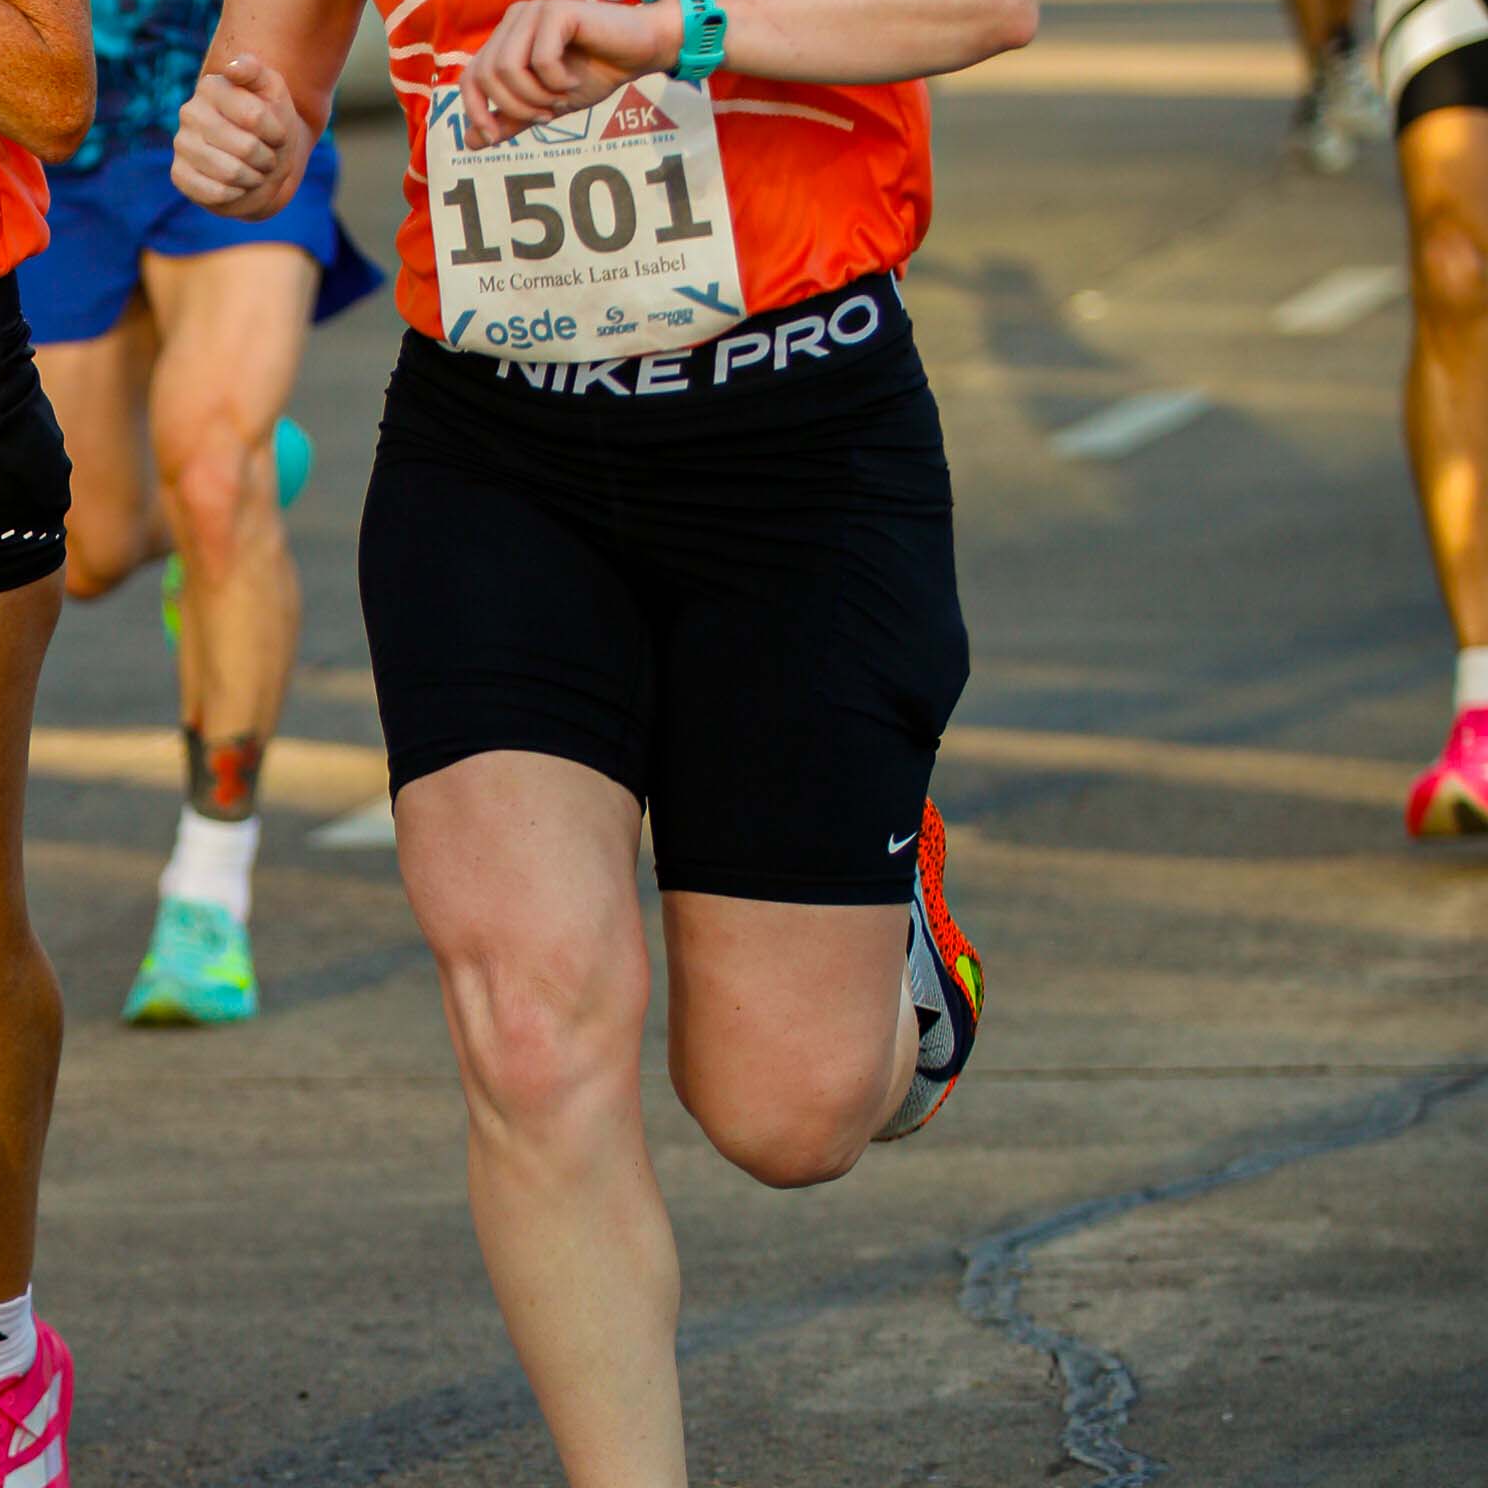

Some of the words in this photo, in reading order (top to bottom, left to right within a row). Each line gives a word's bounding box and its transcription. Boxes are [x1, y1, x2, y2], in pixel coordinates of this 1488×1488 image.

[615, 106, 659, 132] 15K
[443, 153, 713, 266] 1501
[478, 276, 506, 294] Mc
[510, 269, 584, 292] Cormack
[589, 266, 630, 284] Lara
[634, 253, 687, 277] Isabel
[485, 308, 577, 346] osde
[496, 348, 693, 396] NIKE
[713, 294, 879, 385] PRO
